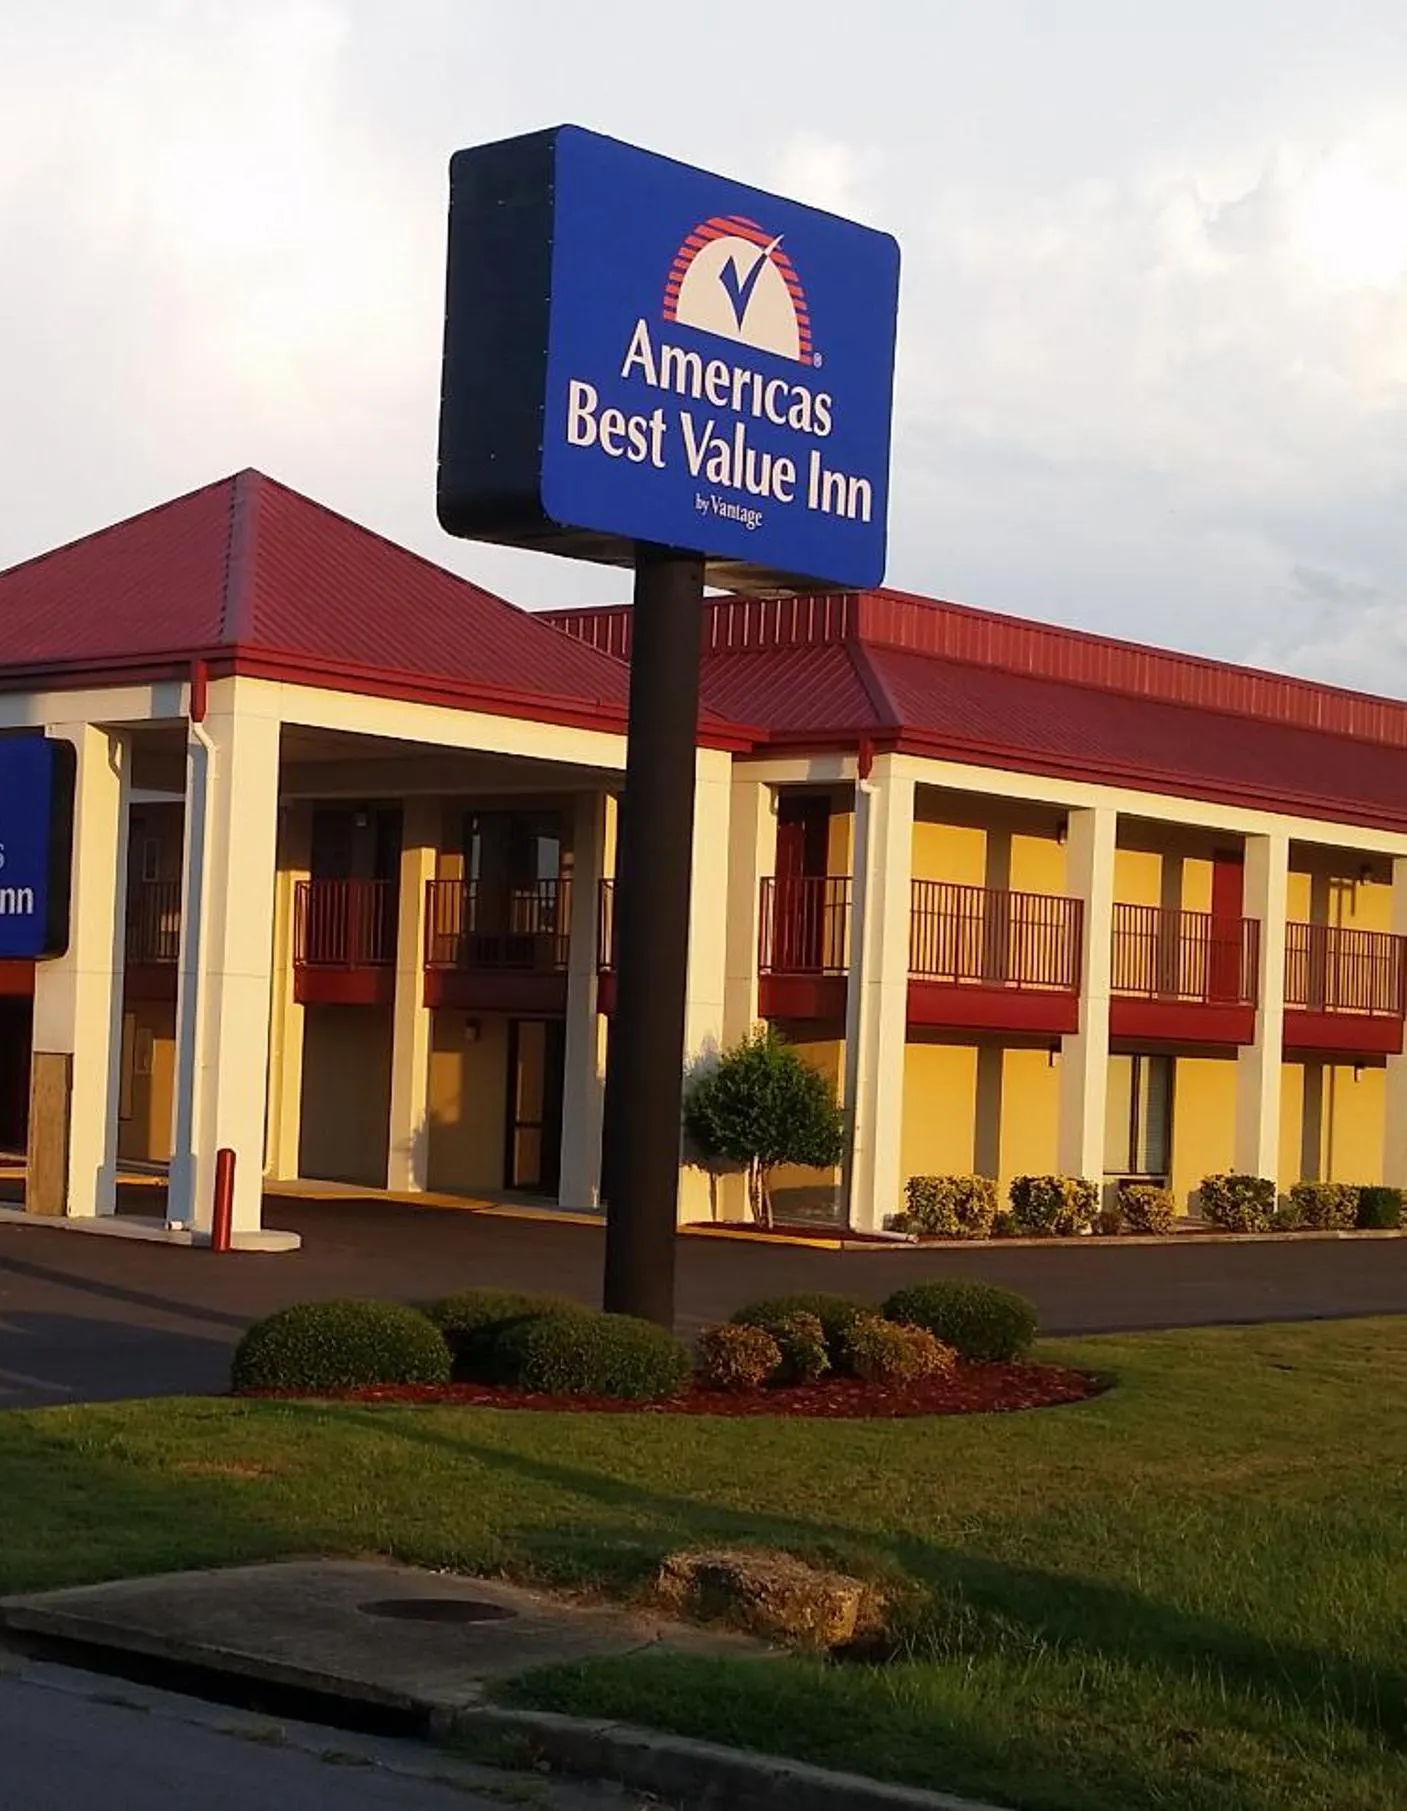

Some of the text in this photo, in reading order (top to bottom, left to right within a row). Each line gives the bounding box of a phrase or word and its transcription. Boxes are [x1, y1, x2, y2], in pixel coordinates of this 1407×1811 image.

[621, 317, 833, 437] Americas
[566, 378, 872, 523] Best Value Inn
[695, 492, 763, 530] by Vantage
